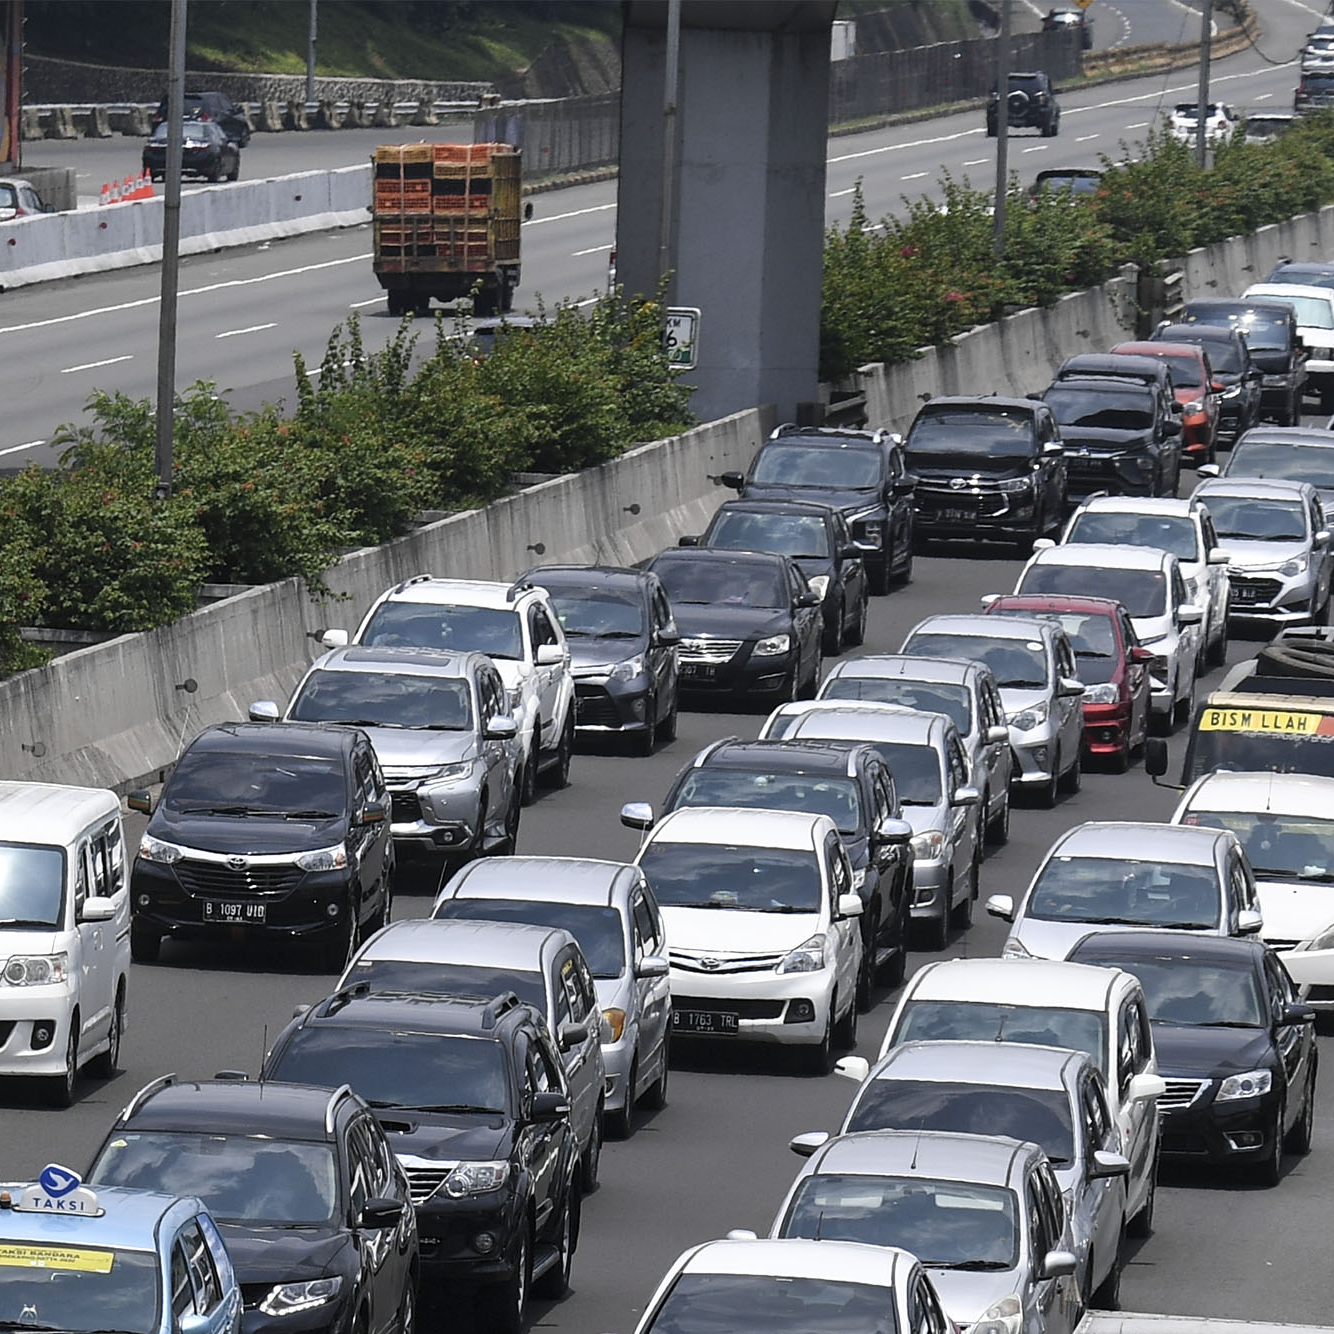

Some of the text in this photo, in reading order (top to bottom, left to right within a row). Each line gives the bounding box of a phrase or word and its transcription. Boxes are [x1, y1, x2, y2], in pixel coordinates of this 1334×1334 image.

[206, 902, 213, 914] B
[220, 903, 242, 916] 1097
[673, 1012, 680, 1025] B
[689, 1013, 712, 1026] 1763
[32, 1197, 85, 1211] TAKSI
[29, 1250, 81, 1259] BANDARA
